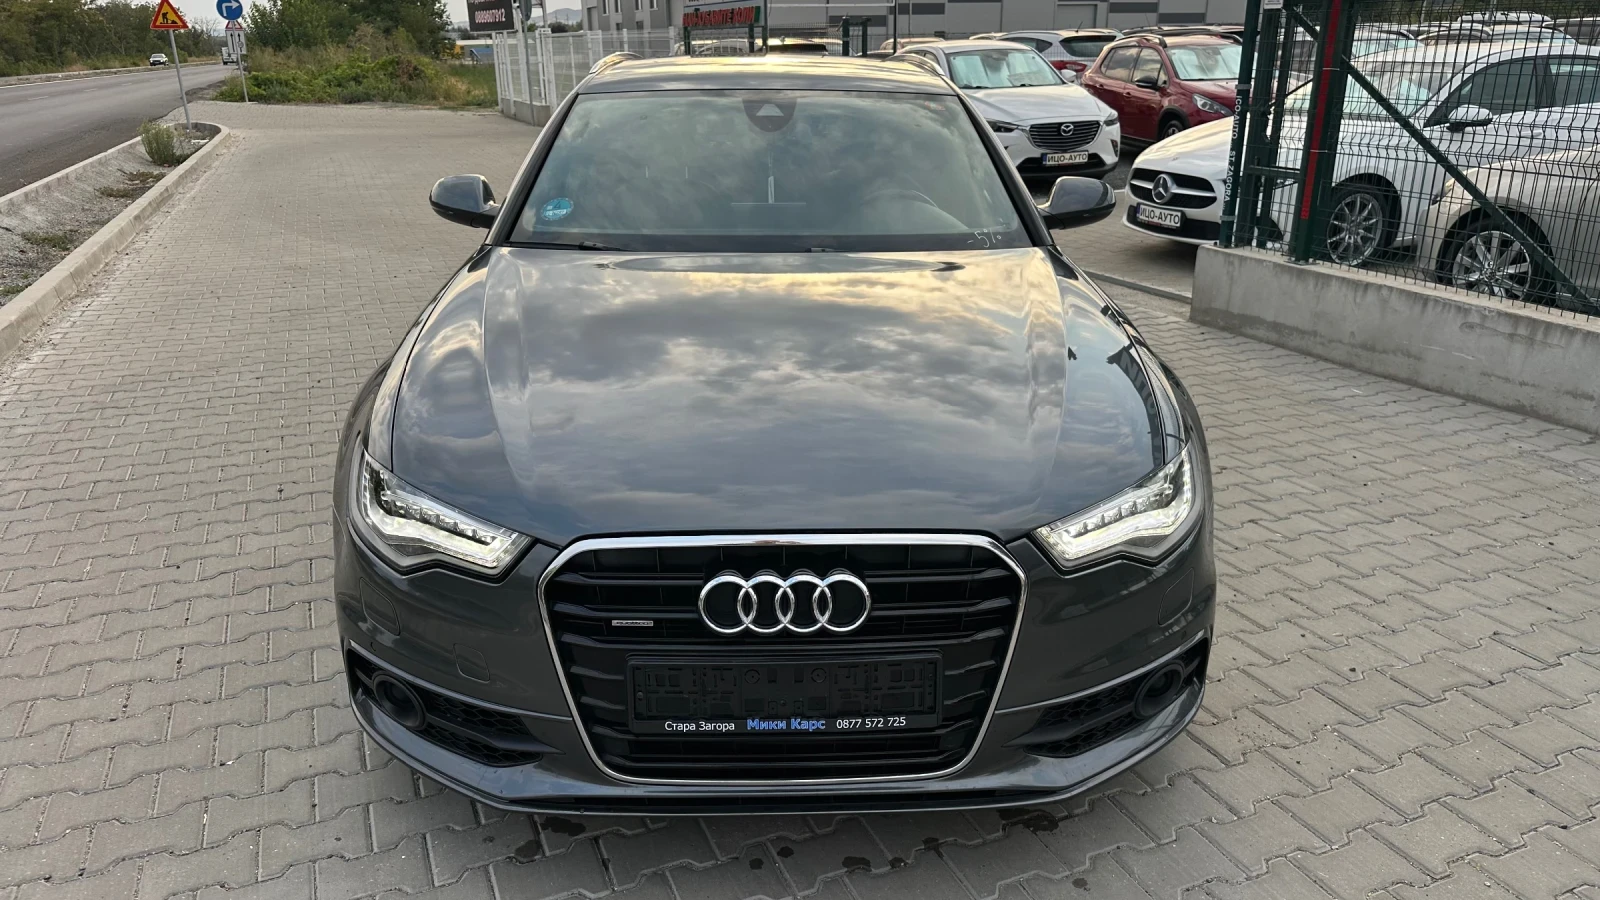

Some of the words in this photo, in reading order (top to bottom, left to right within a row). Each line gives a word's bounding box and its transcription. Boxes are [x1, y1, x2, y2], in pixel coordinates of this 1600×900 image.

[1231, 95, 1243, 140] ICO-AUTO
[1047, 153, 1087, 163] ИЦО-АУТО
[1140, 206, 1180, 225] ИЦО-АУТО
[664, 721, 696, 732] Стара
[698, 721, 735, 732] Загора
[746, 718, 787, 730] Мики
[790, 718, 827, 732] Карс
[836, 719, 862, 729] 0877
[865, 718, 884, 728] 572
[887, 717, 907, 727] 725
